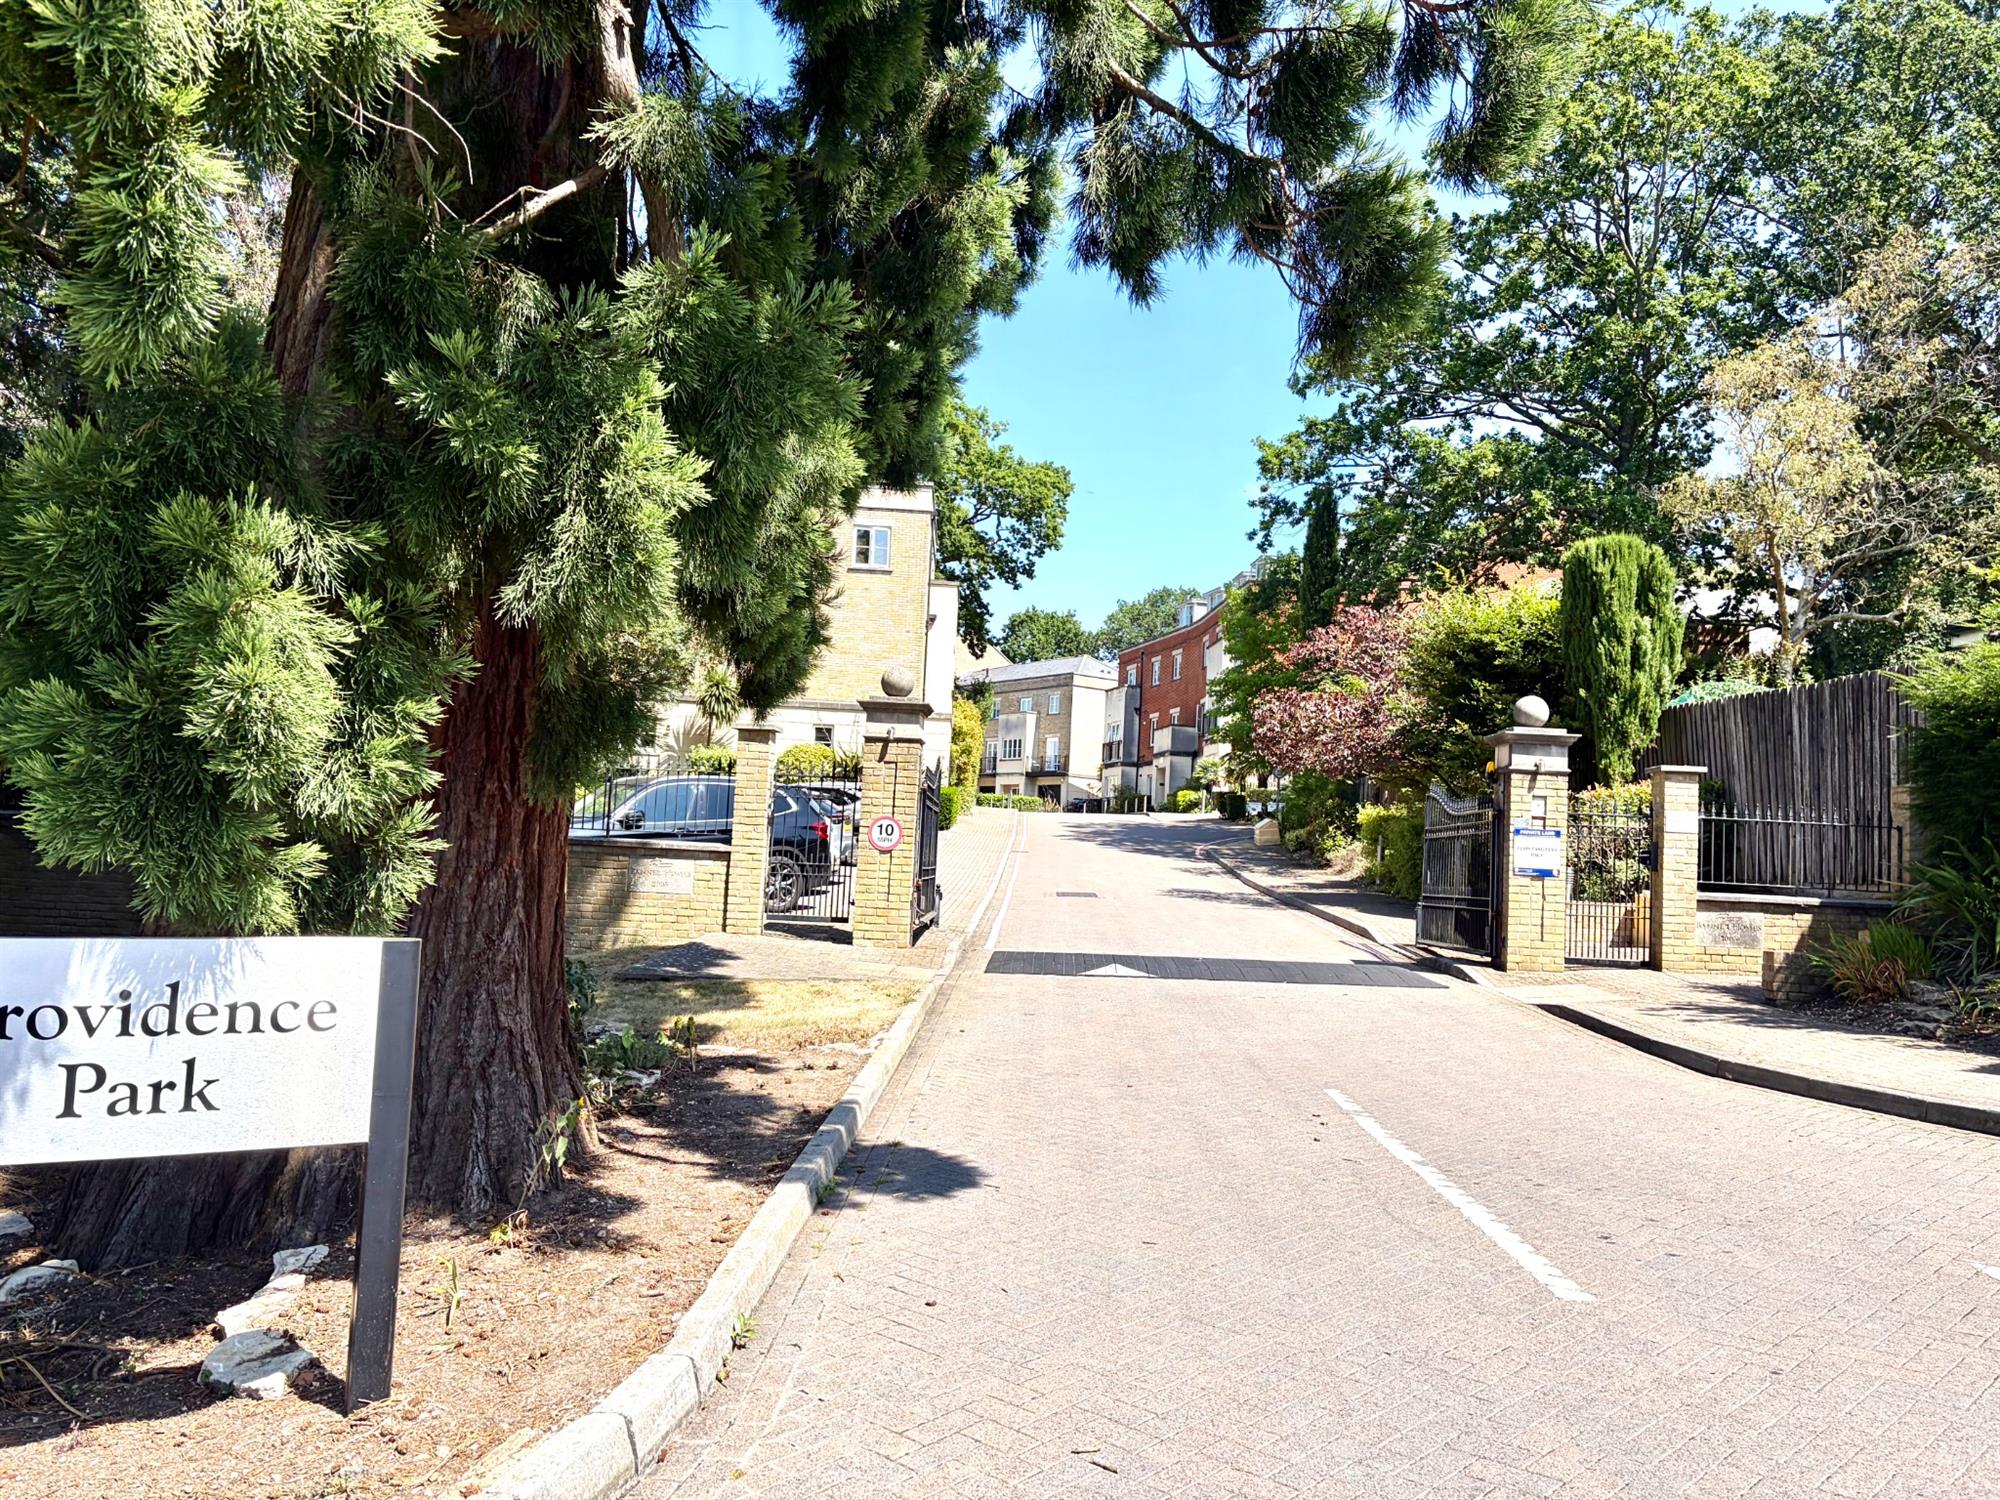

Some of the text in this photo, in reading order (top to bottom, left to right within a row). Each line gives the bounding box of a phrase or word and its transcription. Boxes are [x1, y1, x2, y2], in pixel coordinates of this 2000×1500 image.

[877, 823, 895, 837] 10
[0, 980, 338, 1040] rovidence
[55, 1056, 221, 1119] Park
